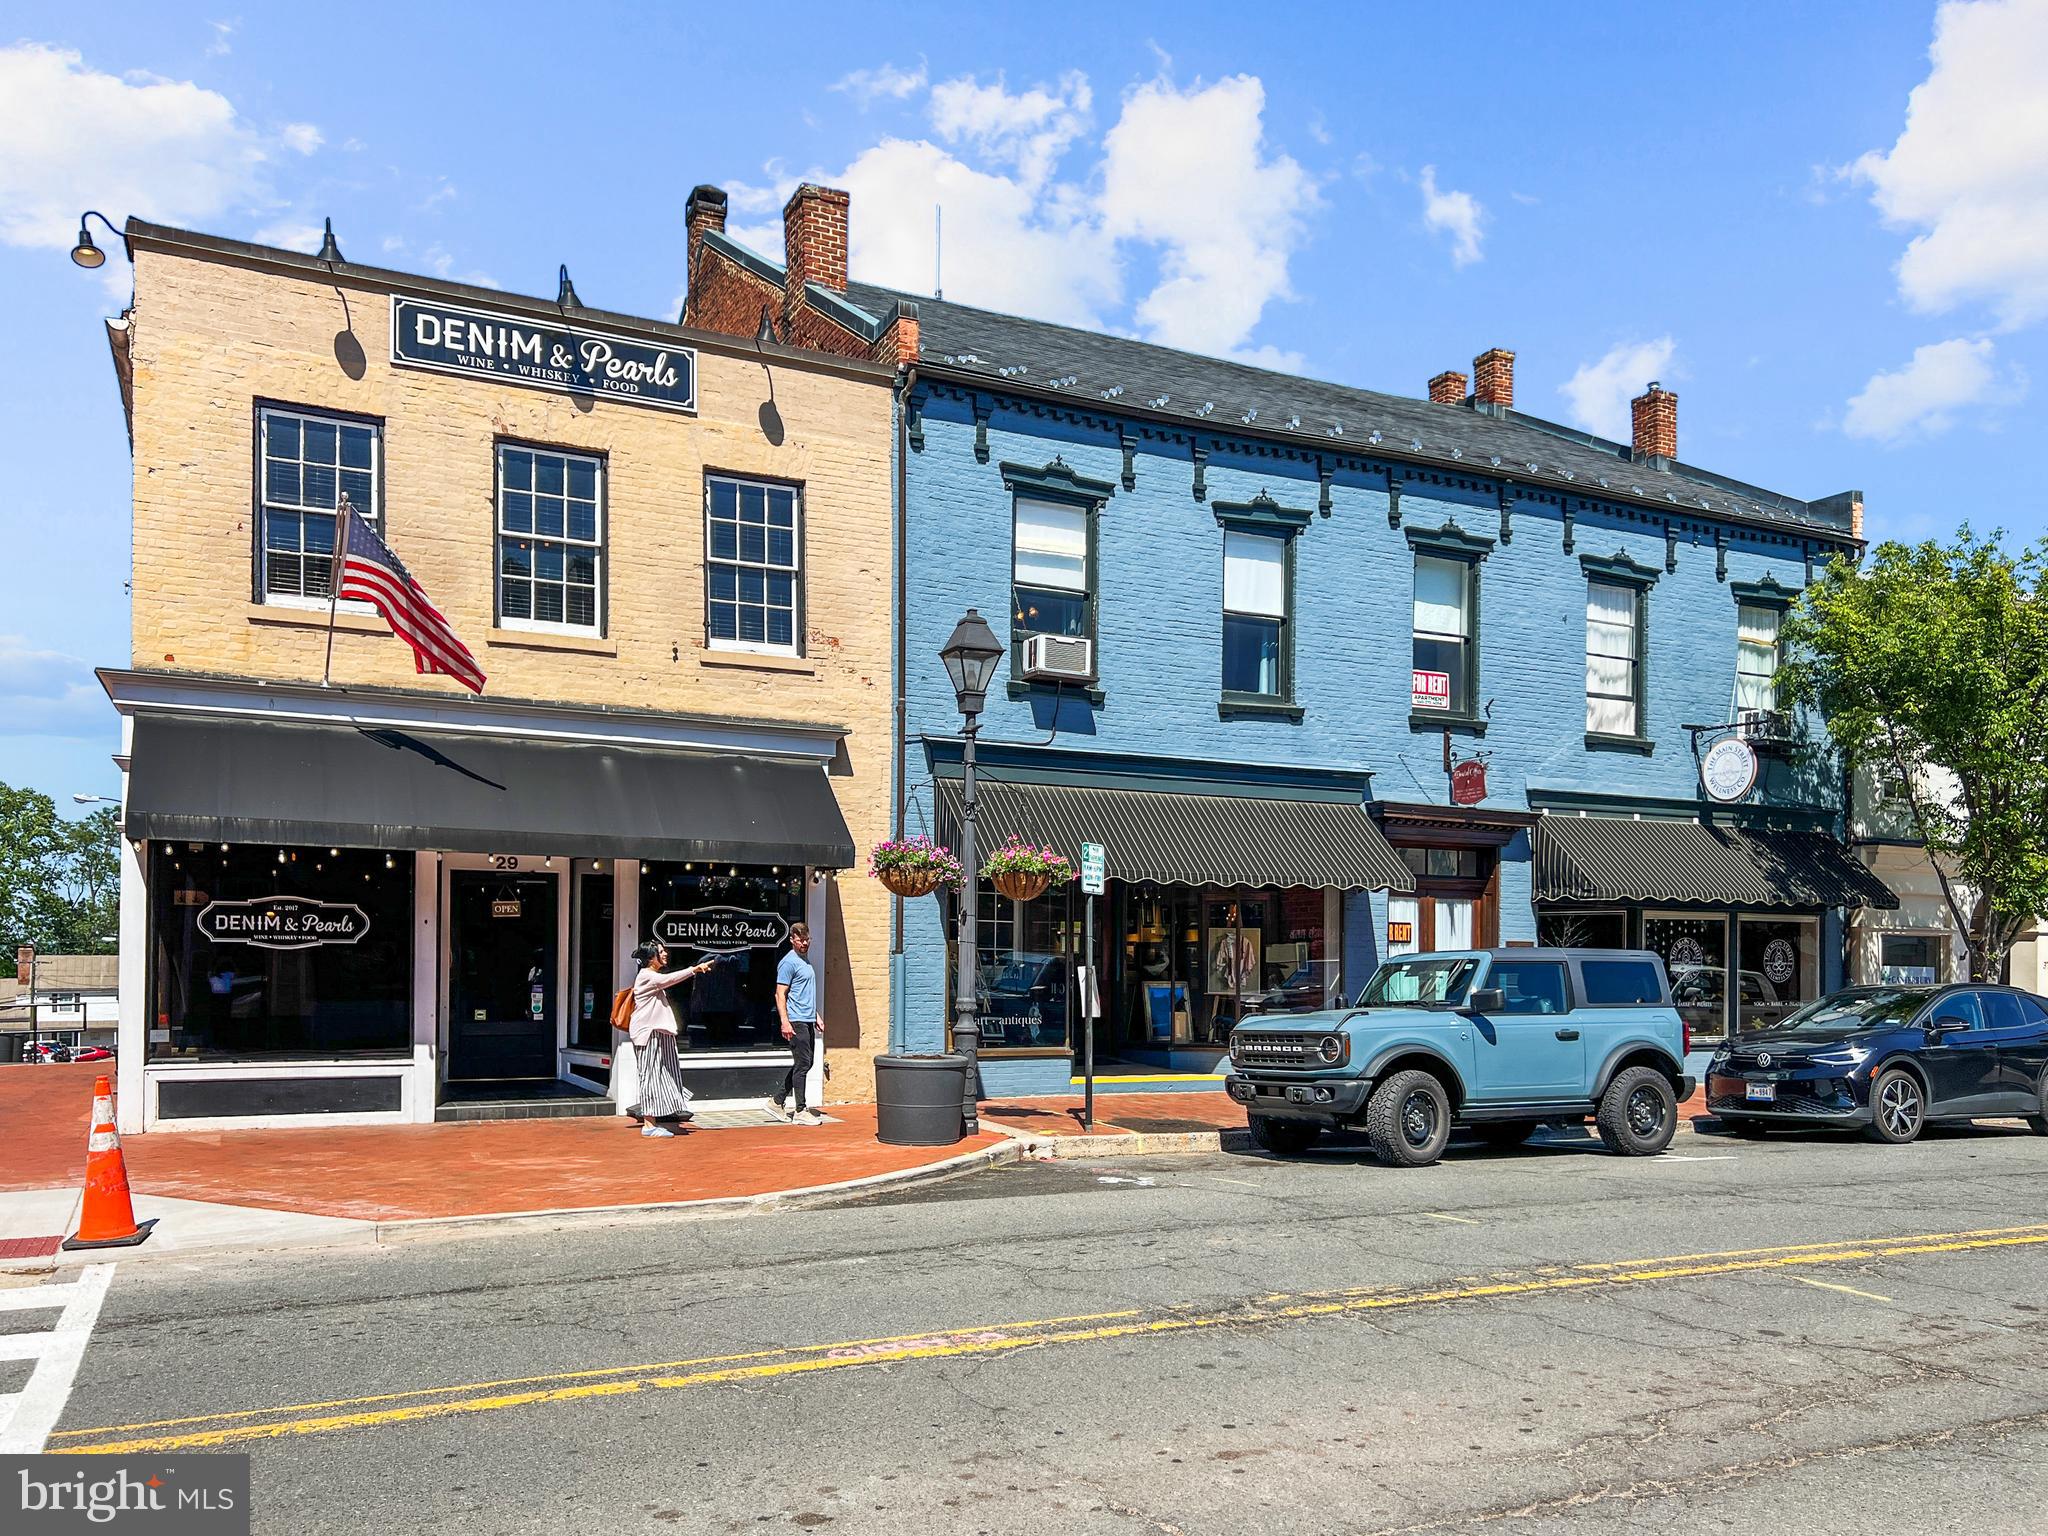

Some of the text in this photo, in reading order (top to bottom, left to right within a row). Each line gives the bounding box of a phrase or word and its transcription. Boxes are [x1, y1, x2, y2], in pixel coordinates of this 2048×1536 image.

[415, 312, 679, 387] DENIM & Pearls
[456, 354, 639, 393] WINE WHISKEY FOOD
[1413, 673, 1446, 695] FOR RENT
[1716, 745, 1733, 757] MAIN
[1734, 746, 1749, 768] STREET
[1710, 776, 1737, 795] WELLNESS
[1083, 844, 1089, 860] 2
[496, 856, 518, 869] 29
[494, 905, 518, 913] OPEN
[215, 914, 354, 932] DENIM & Pearls
[667, 921, 777, 938] DENIM & Pearls
[1395, 924, 1411, 941] RENT
[999, 1014, 1042, 1027] antiques
